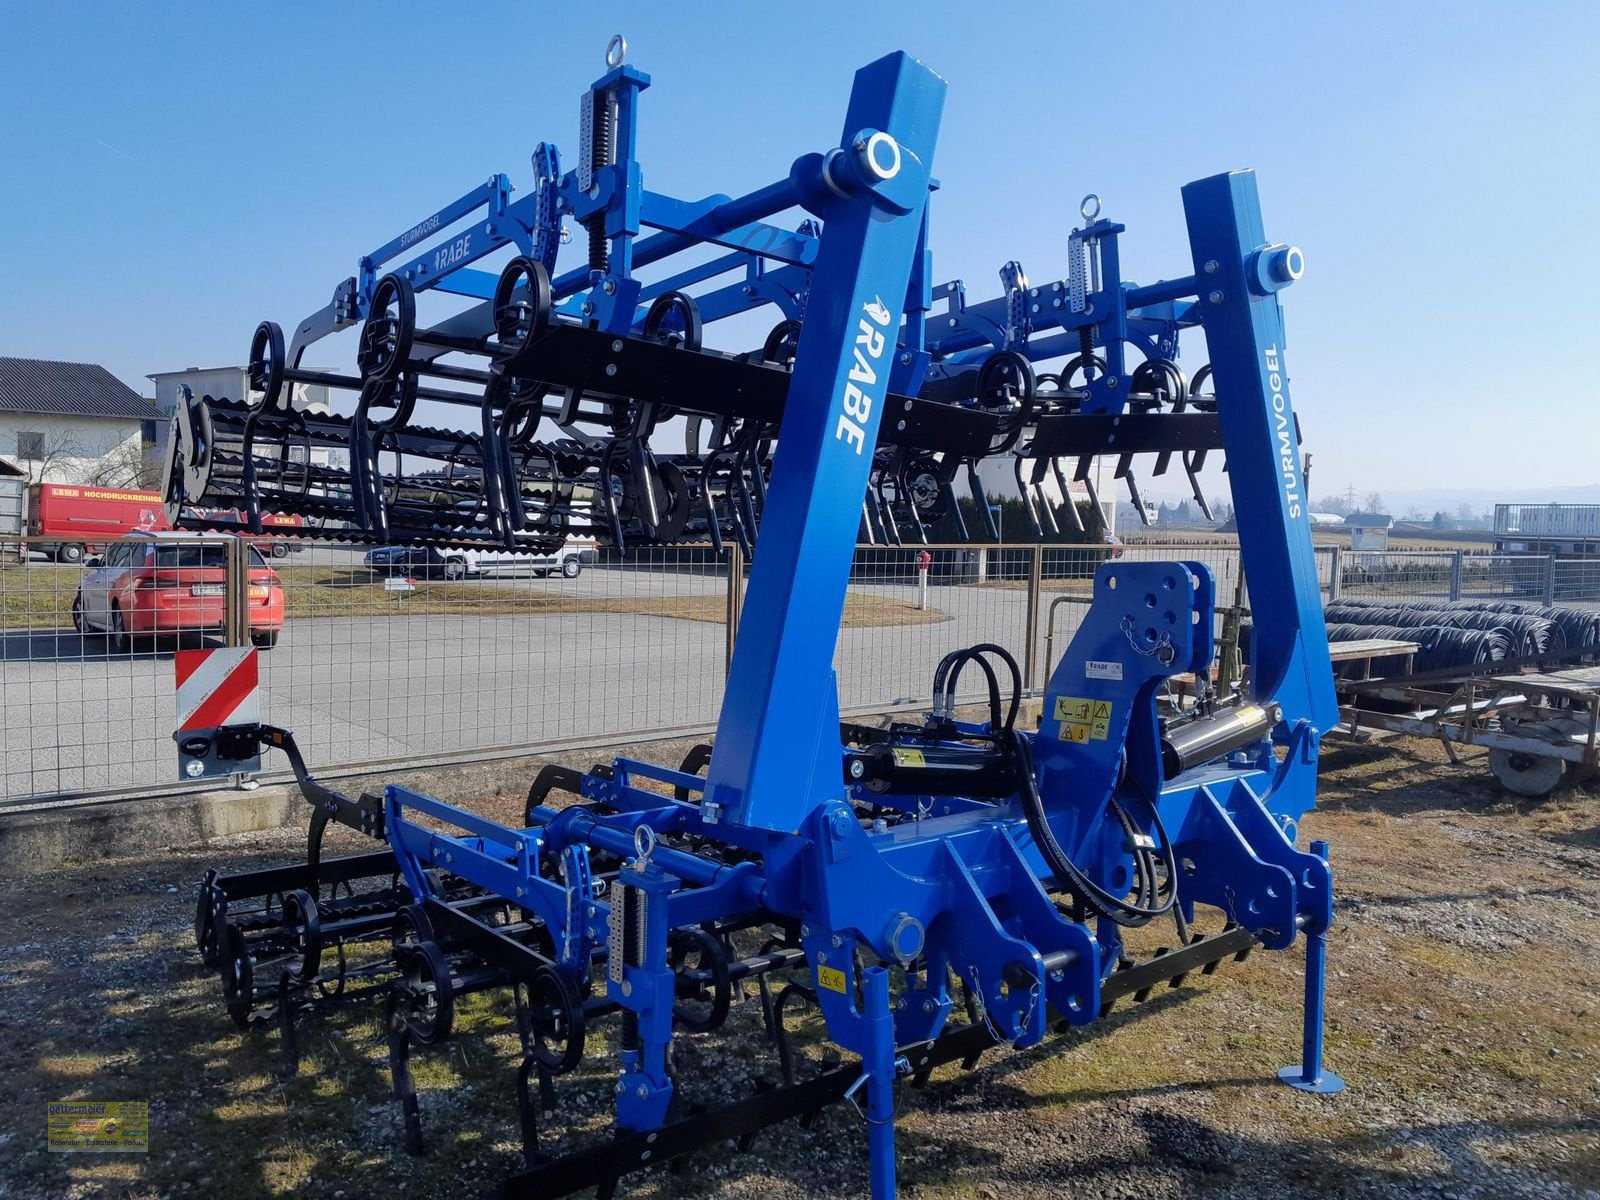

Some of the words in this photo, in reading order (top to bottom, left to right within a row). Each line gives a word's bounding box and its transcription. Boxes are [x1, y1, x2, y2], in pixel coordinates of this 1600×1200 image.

[400, 214, 440, 247] STURMVOGEL
[440, 234, 472, 270] RABE
[835, 318, 886, 456] RABE
[1265, 343, 1300, 519] STURMVOGEL
[274, 516, 295, 525] LEMA
